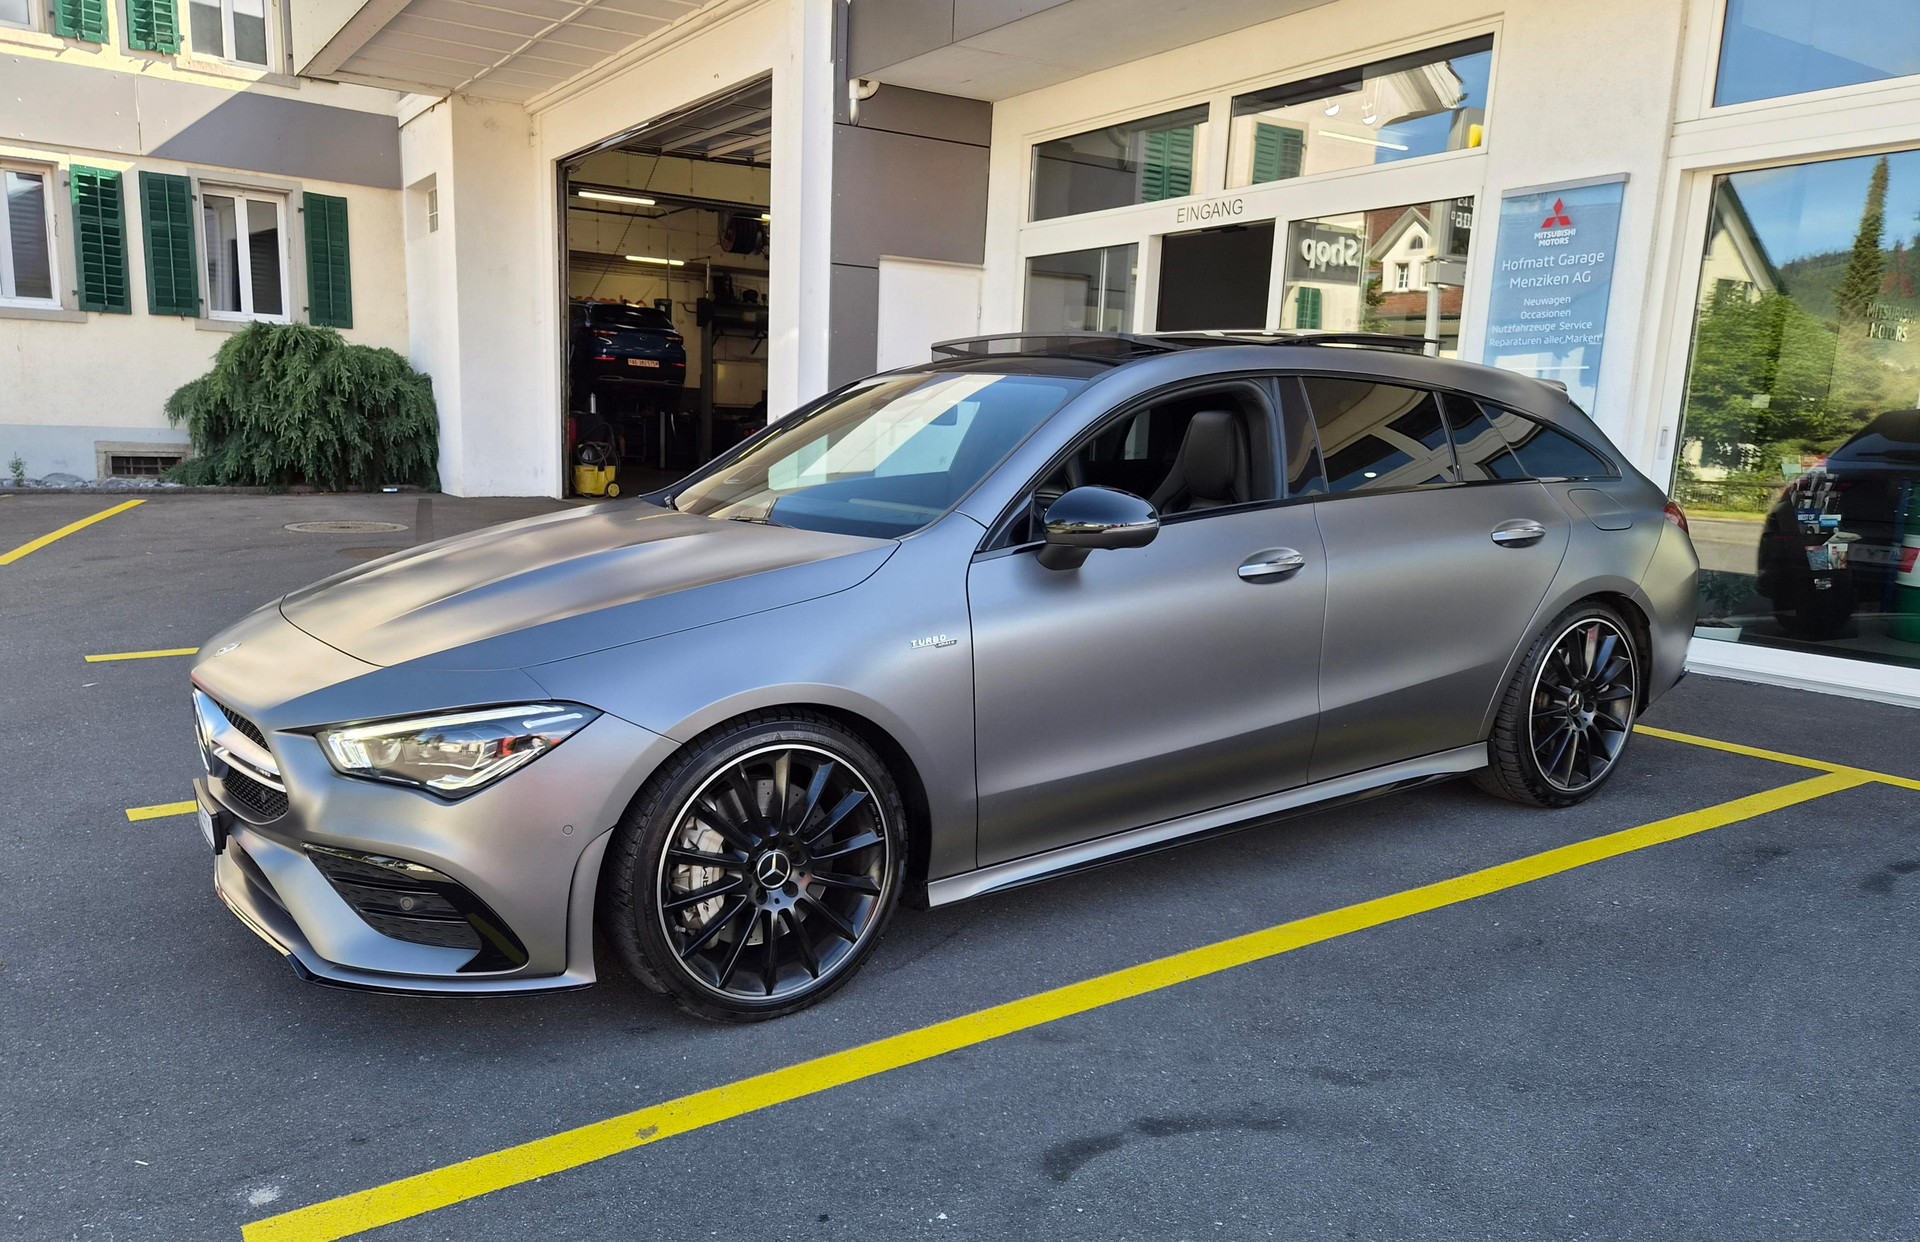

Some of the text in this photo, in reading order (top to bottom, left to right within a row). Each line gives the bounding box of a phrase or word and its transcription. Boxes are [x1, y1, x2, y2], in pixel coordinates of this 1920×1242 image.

[1177, 198, 1243, 223] EINGANG
[1534, 228, 1577, 240] MITSUBISHI
[1538, 237, 1569, 247] MOTORS
[1502, 252, 1605, 271] Hofmatt Garage
[1509, 271, 1591, 289] Menziken AG
[1523, 296, 1571, 307] Neuwagen
[1520, 309, 1571, 320] Occasionen
[1492, 321, 1593, 334] Nutzfahrzeuge Service
[1489, 337, 1542, 348] Reparaturen
[910, 634, 947, 648] TURBO
